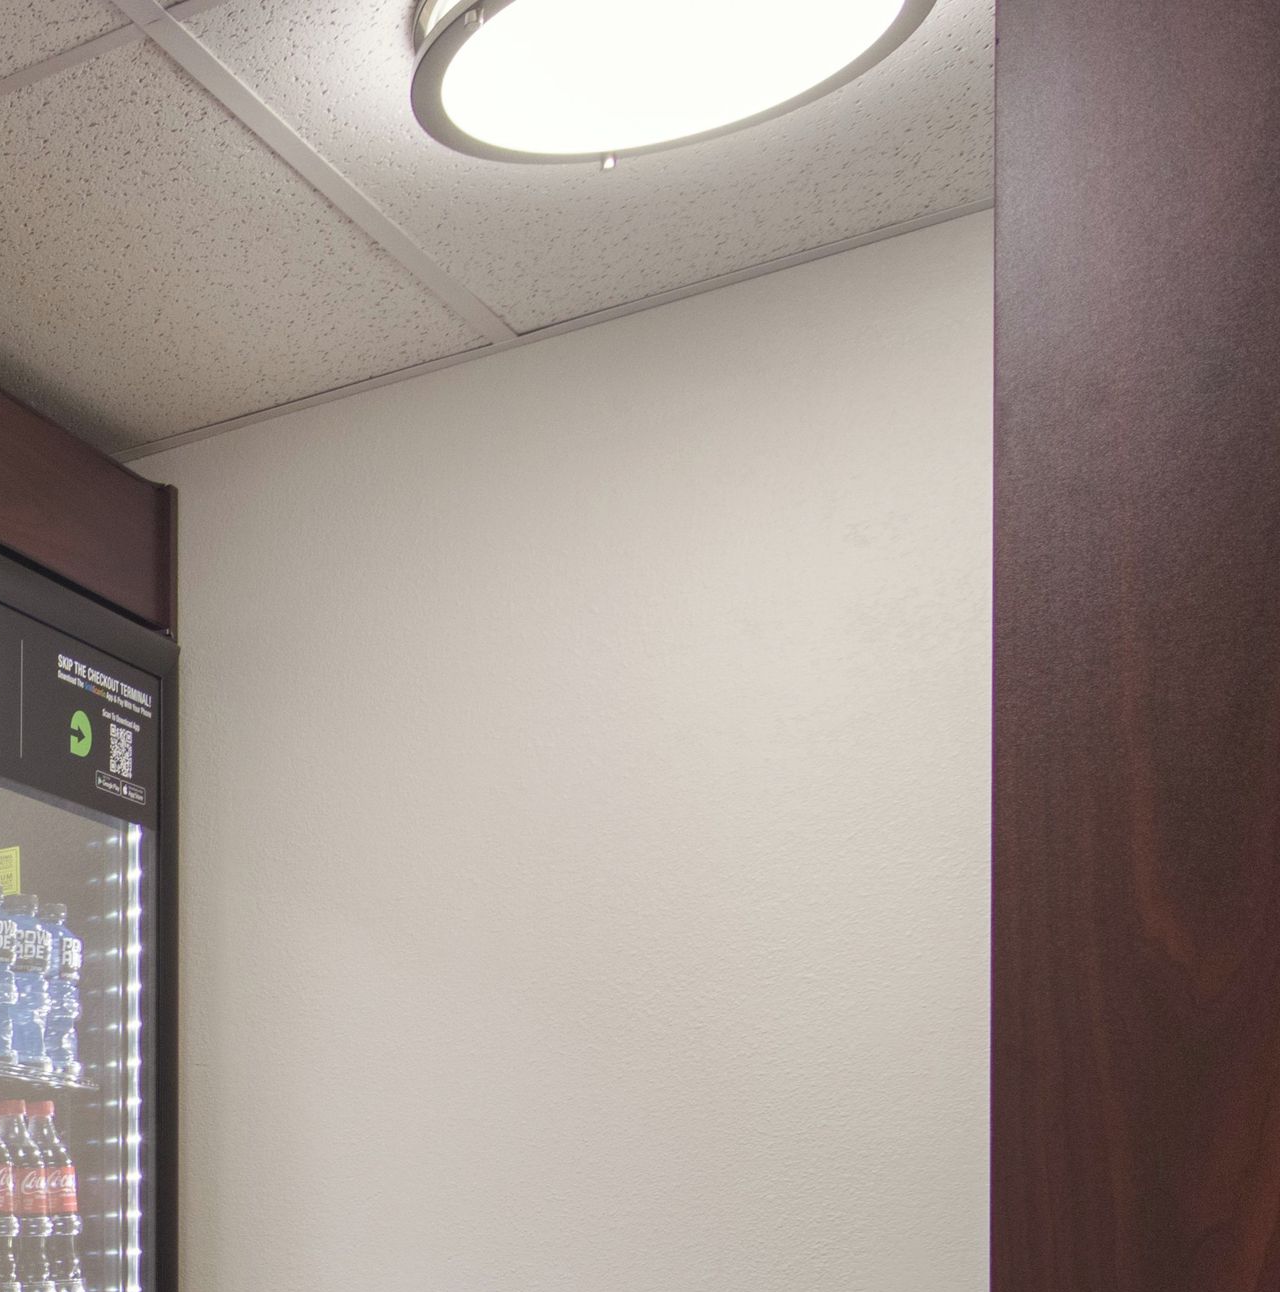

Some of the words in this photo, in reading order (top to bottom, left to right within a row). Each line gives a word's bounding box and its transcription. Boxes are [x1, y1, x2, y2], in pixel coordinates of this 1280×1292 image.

[58, 653, 73, 671] SKIP
[74, 661, 87, 679] THE
[88, 667, 120, 692] CHECKOUT
[120, 683, 152, 708] TERMINAL!
